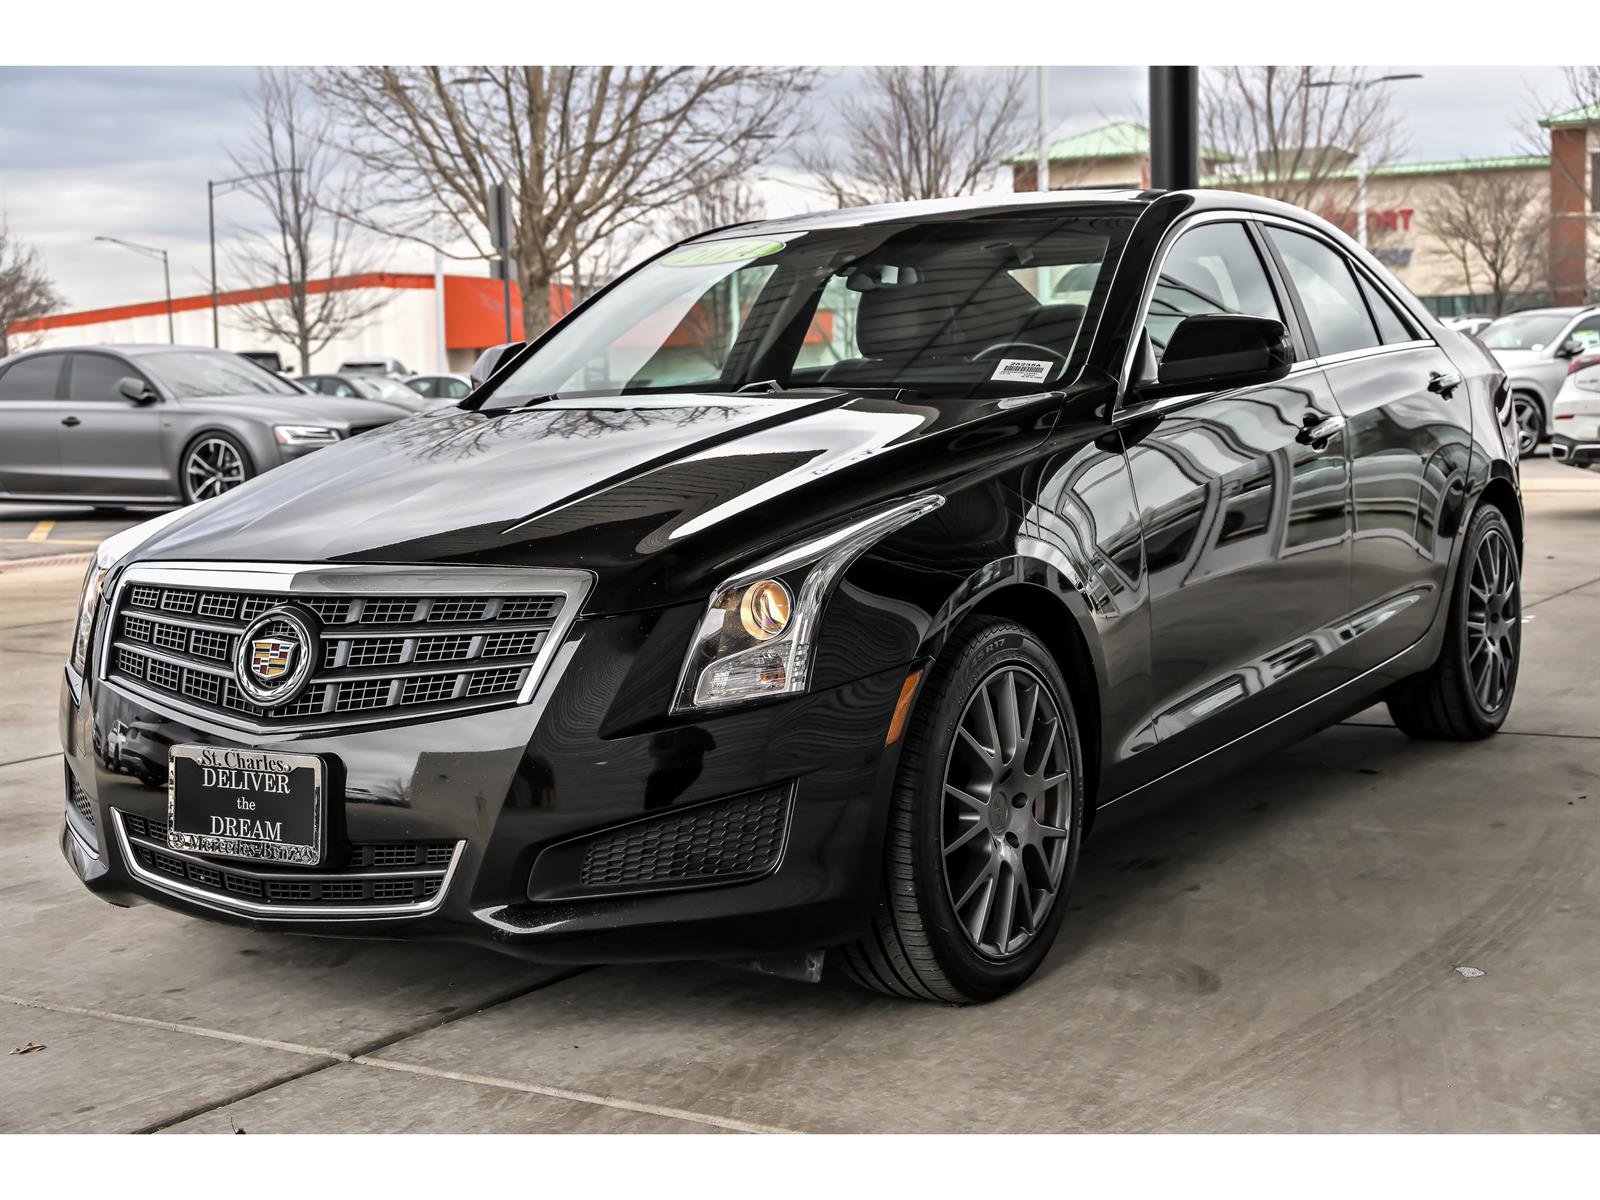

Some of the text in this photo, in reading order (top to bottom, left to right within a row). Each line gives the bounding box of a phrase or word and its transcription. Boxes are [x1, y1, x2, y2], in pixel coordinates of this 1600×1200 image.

[202, 750, 283, 772] St. Charles
[202, 767, 290, 794] DELIVER
[236, 797, 256, 811] the
[209, 816, 283, 842] DREAM
